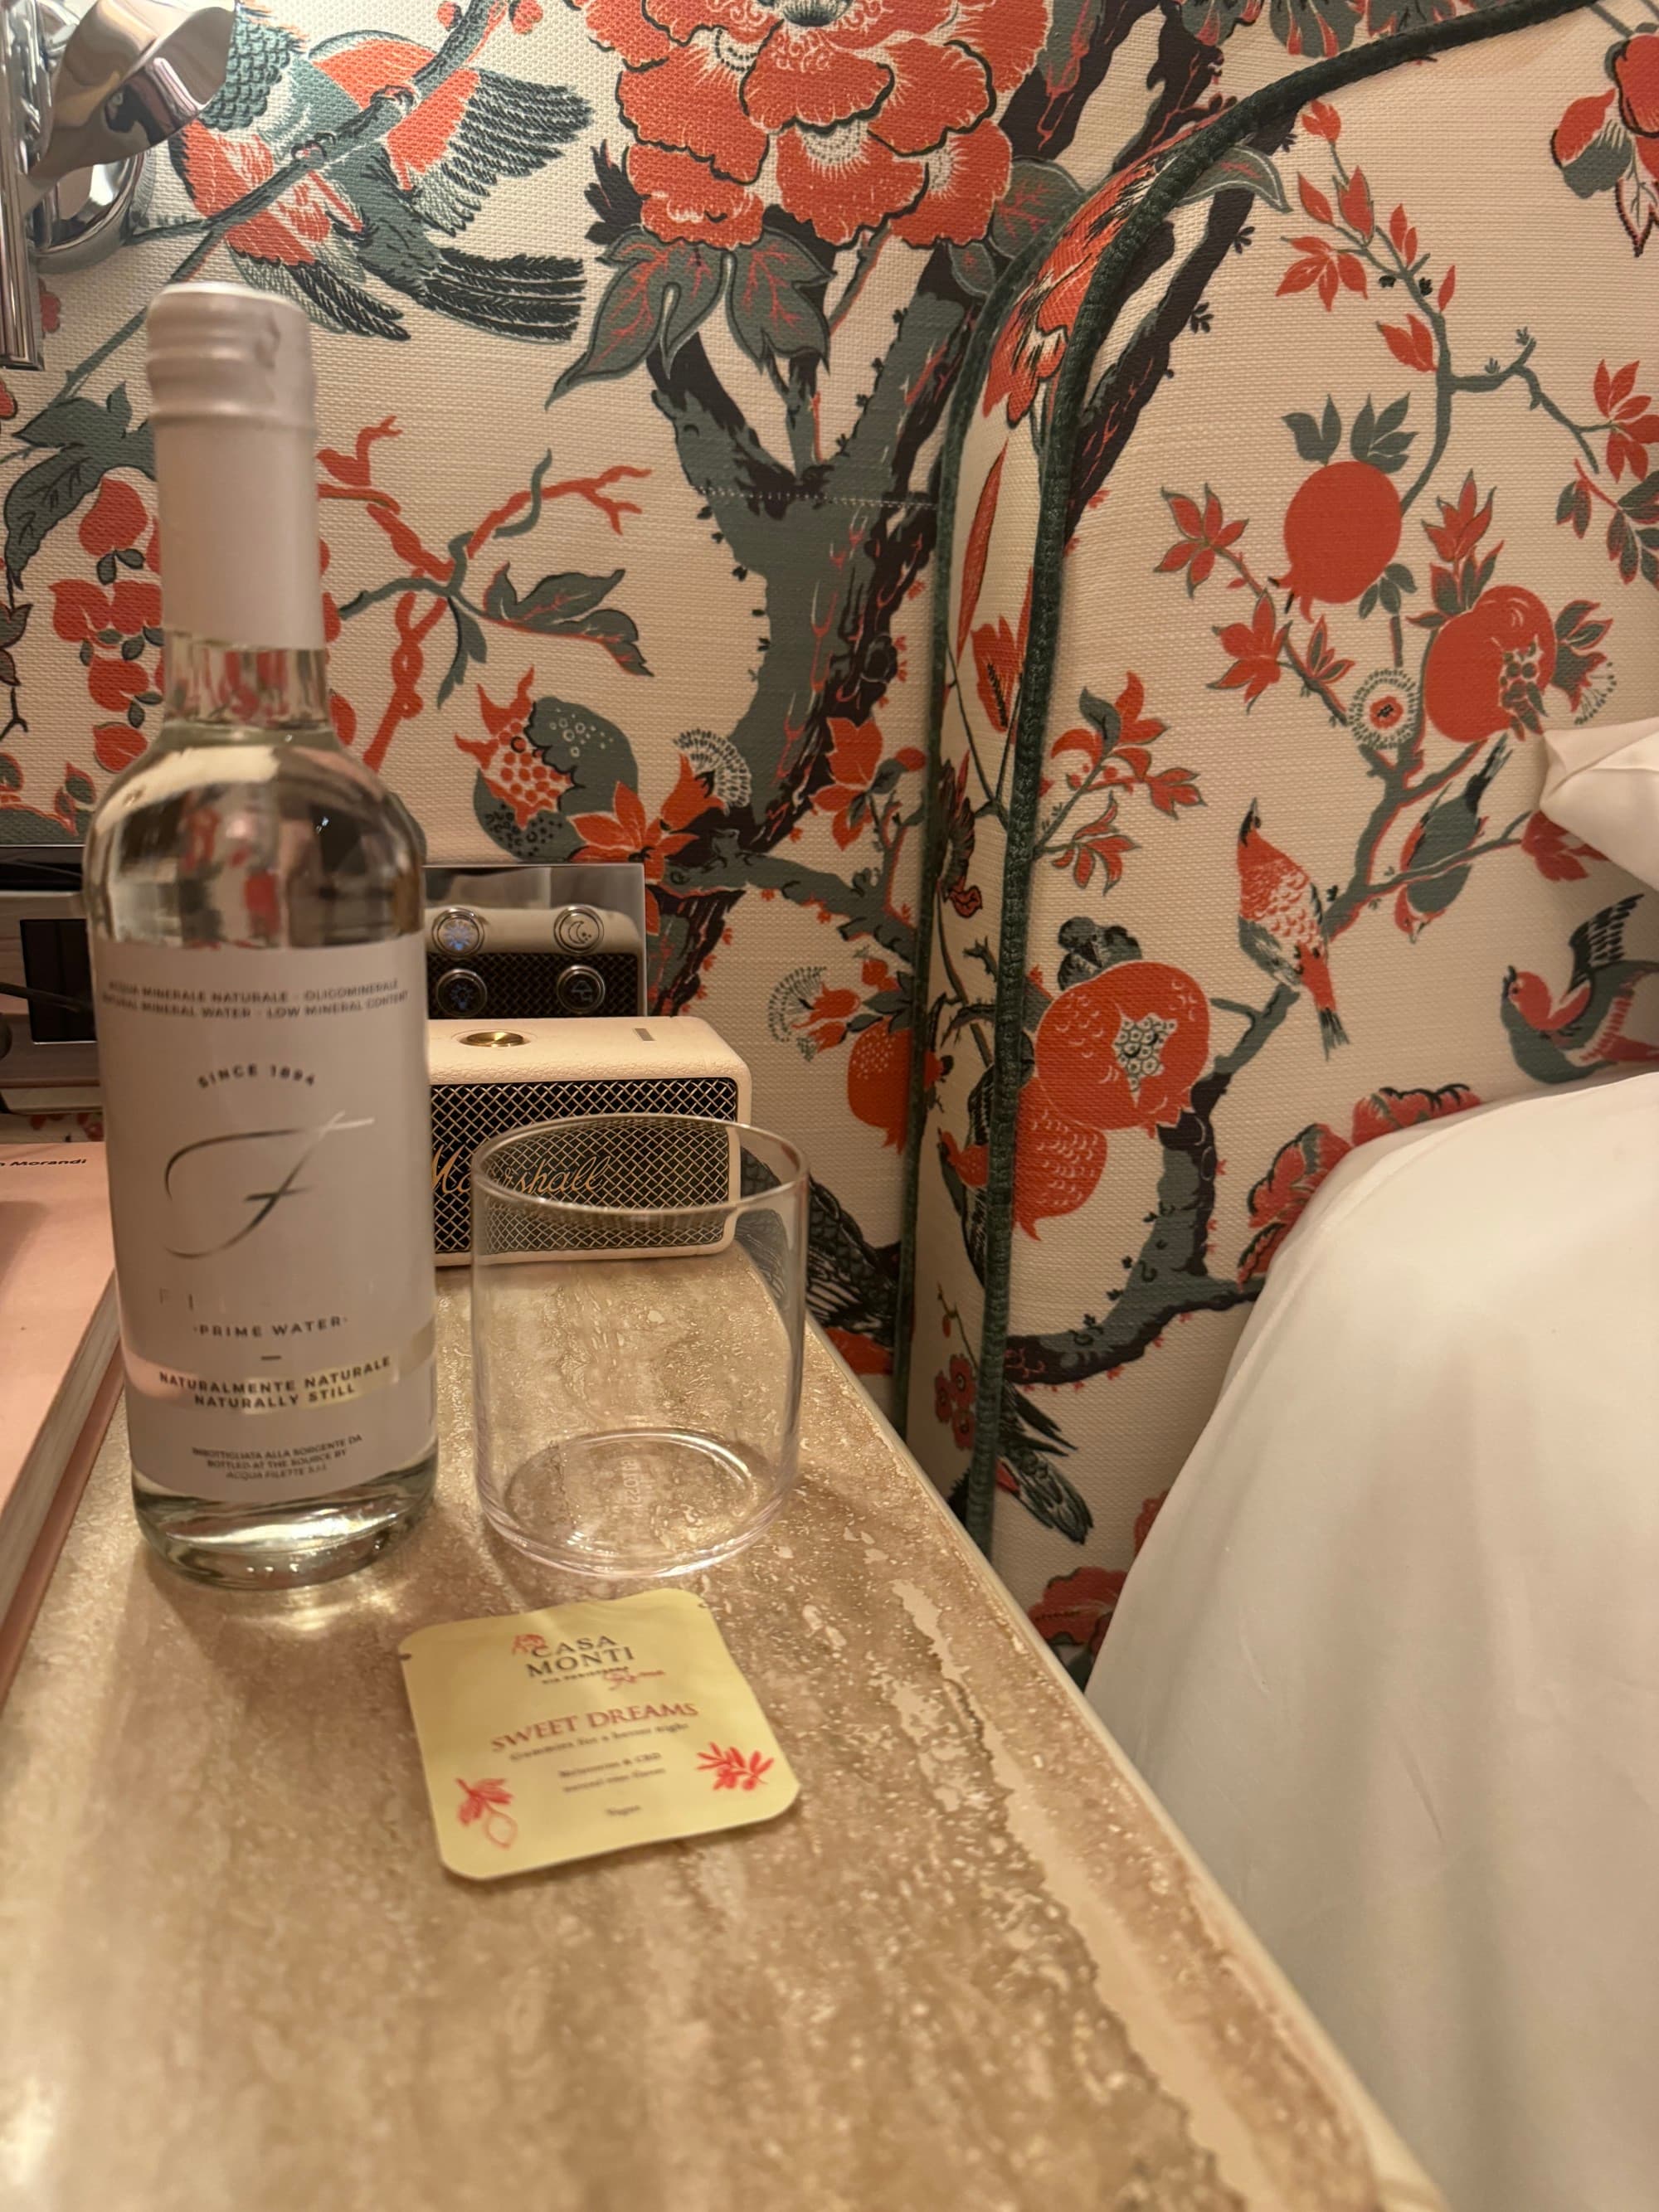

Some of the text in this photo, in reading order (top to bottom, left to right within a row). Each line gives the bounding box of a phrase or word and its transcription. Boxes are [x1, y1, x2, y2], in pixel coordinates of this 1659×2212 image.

[202, 1006, 251, 1018] WATER
[266, 1006, 300, 1019] LOW
[304, 1000, 362, 1017] MINERAL
[197, 1062, 257, 1089] SINCE
[159, 1356, 391, 1395] NATURALMENTE NATURALE
[194, 1383, 355, 1408] NATURALLY STILL
[532, 1635, 618, 1658] CASA
[526, 1646, 635, 1678] MONTI
[490, 1703, 698, 1753] SWEET DREAMS
